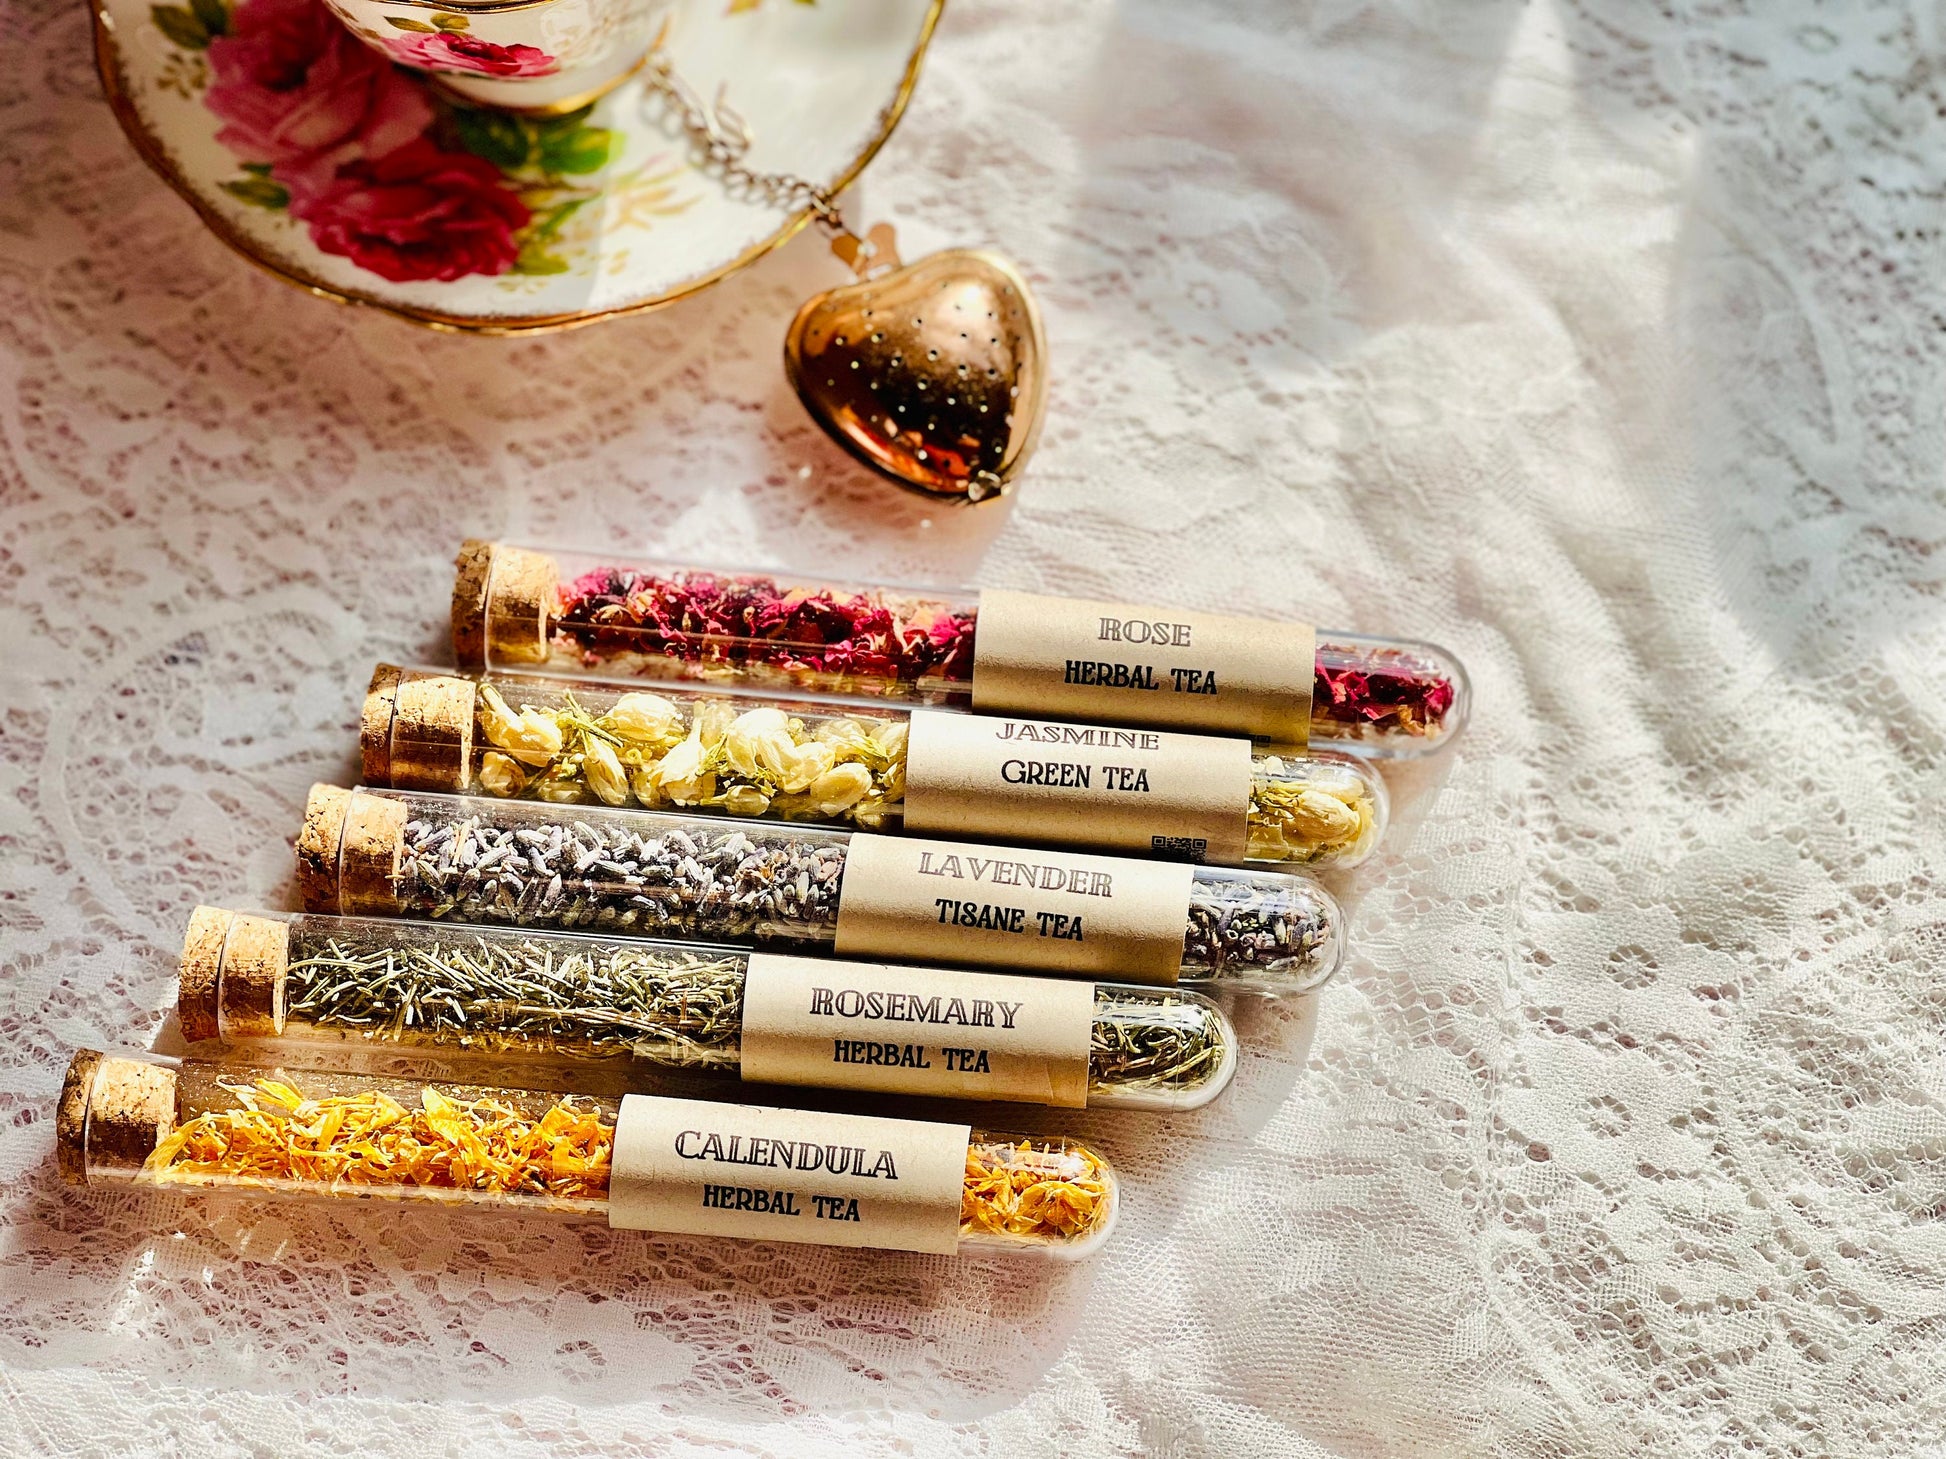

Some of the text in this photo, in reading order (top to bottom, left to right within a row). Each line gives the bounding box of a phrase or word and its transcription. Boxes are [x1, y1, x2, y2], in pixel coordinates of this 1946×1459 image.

[1097, 617, 1192, 647] ROSE
[1063, 659, 1217, 695] HERBAL TEA
[995, 722, 1160, 750] JASMINE
[1000, 759, 1150, 792] GREEN TEA
[918, 851, 1113, 898] LAVENDER
[935, 898, 1084, 941] TISANE TEA
[809, 987, 1024, 1029] ROSEMARY
[833, 1039, 991, 1073] HERBAL TEA
[674, 1130, 899, 1180] CALENDULA
[702, 1184, 861, 1222] HERBAL TEA
